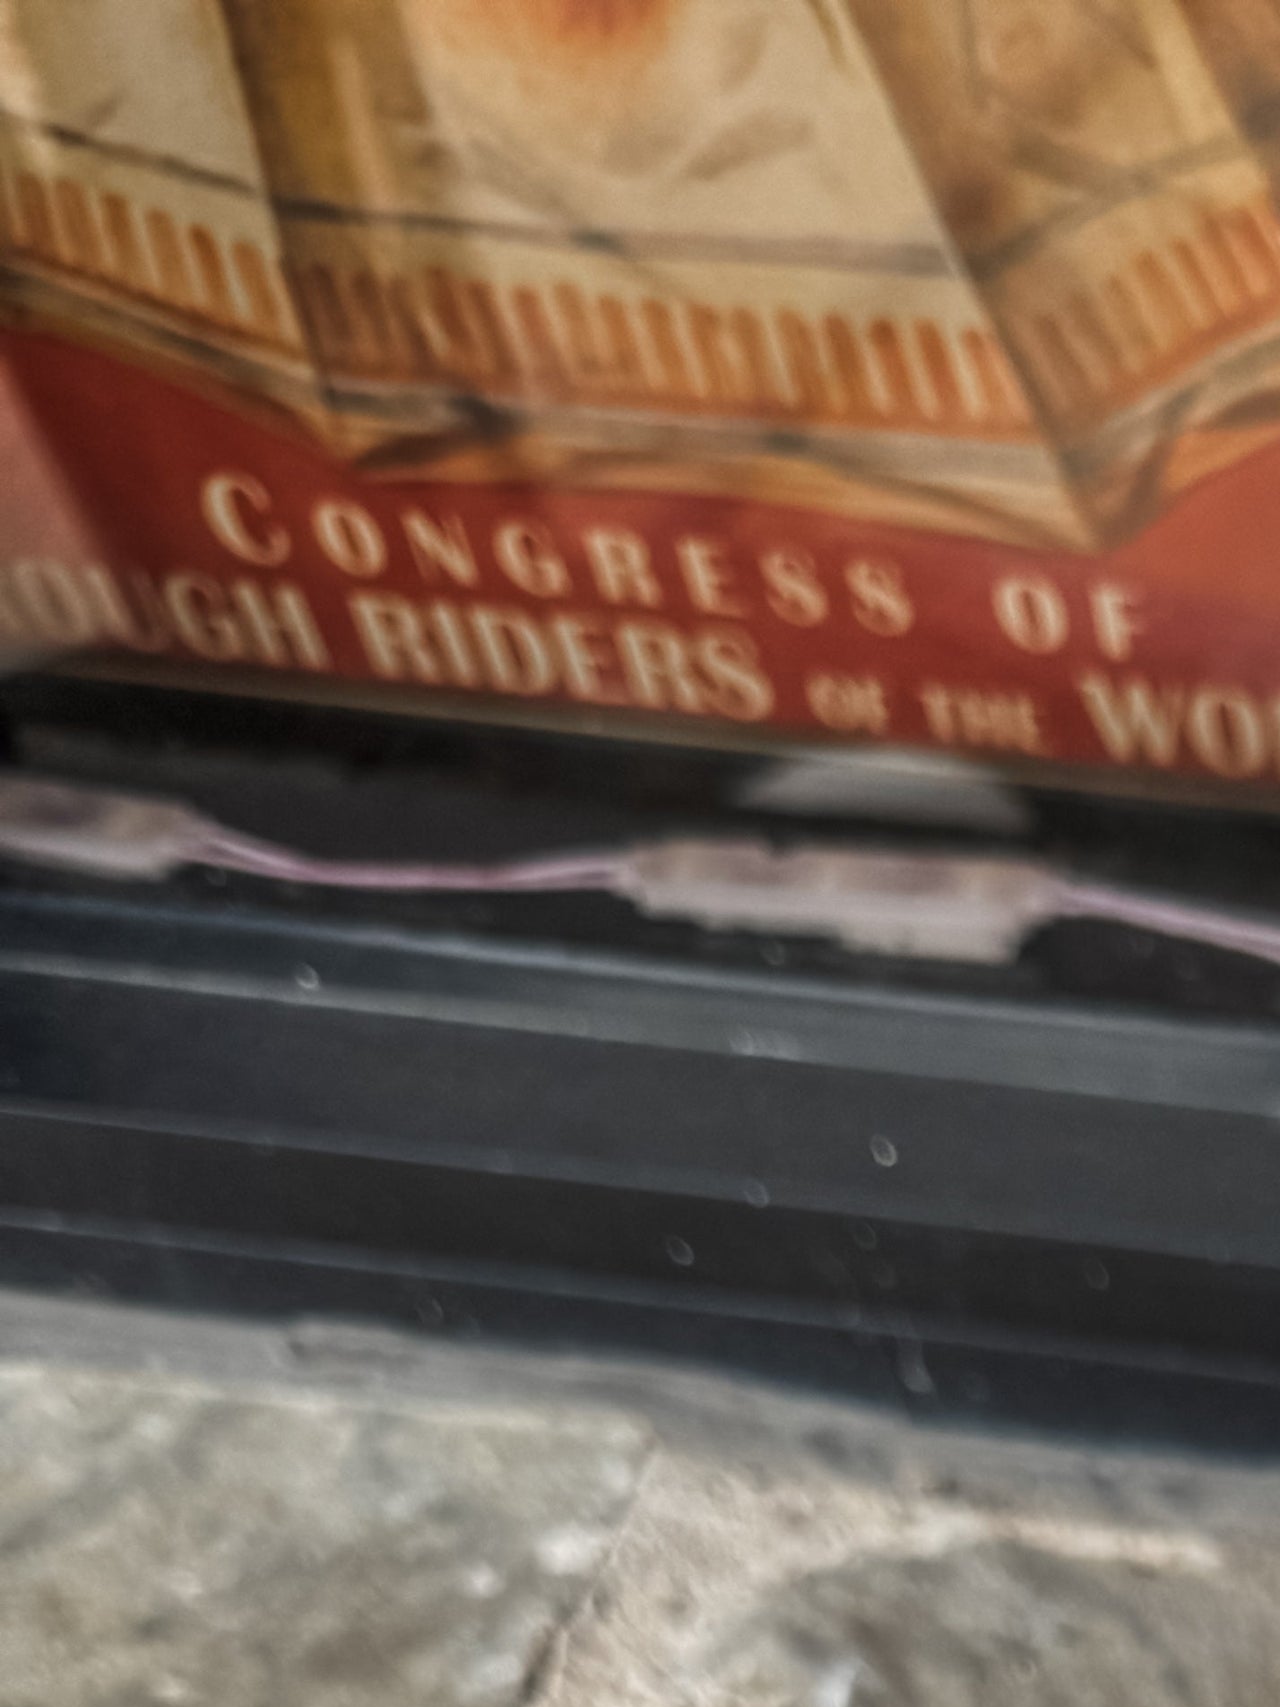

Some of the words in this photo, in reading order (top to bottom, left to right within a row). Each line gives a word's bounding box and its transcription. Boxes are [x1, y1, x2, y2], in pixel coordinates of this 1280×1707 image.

[0, 557, 331, 670] OUGH
[346, 590, 776, 722] RIDERS
[203, 472, 914, 638] CONGRESS
[992, 572, 1147, 662] OF
